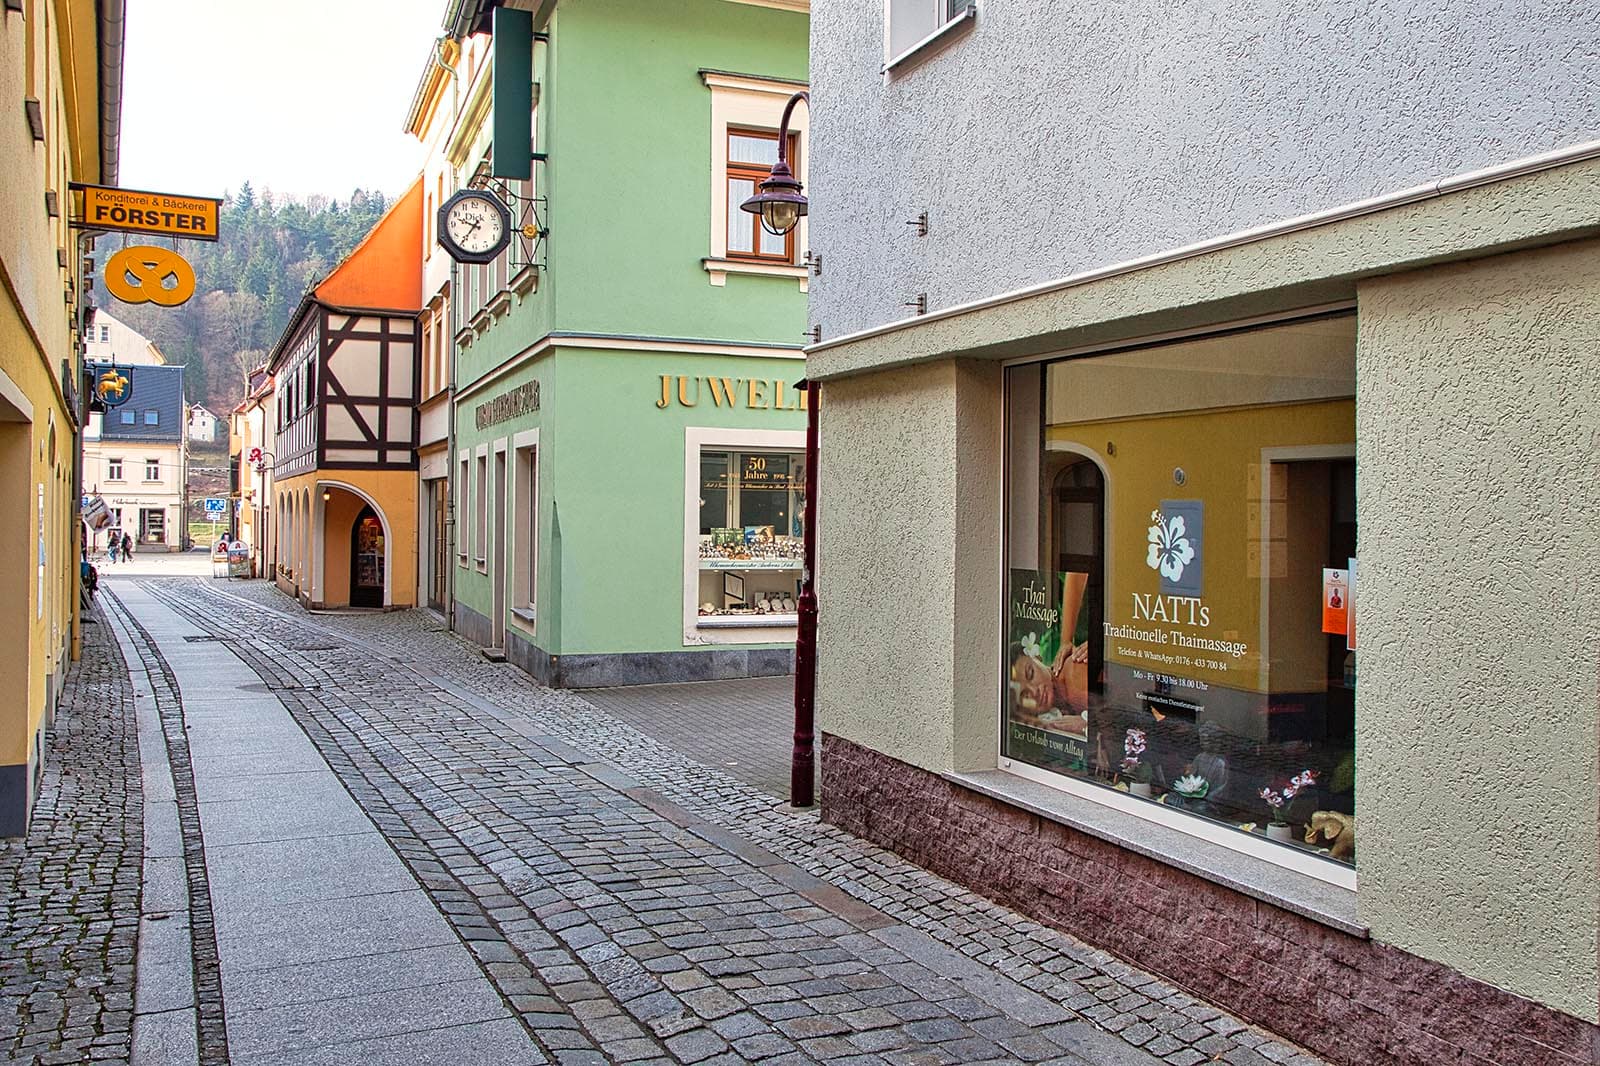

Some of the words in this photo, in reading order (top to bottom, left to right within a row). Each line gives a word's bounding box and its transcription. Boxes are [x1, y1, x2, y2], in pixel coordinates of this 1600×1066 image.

[95, 191, 149, 206] Konditorei
[162, 199, 208, 212] Bäckerei
[95, 203, 207, 231] FÖRSTER
[465, 212, 485, 222] Dick
[744, 470, 768, 480] Jahre
[748, 457, 767, 471] 50
[1022, 581, 1046, 606] Thai
[1016, 602, 1058, 628] Massage
[1132, 592, 1210, 627] NATTs
[1103, 622, 1168, 644] Traditionelle
[1170, 630, 1248, 658] Thaimassage
[1117, 646, 1137, 658] Telefon
[1137, 649, 1143, 658] &
[1144, 650, 1175, 664] WhatsApp:
[1175, 655, 1191, 666] 0176
[1194, 658, 1206, 668] 433
[1207, 660, 1219, 670] 700
[1219, 661, 1227, 672] 84
[1133, 670, 1144, 679] Mo
[1156, 673, 1169, 684] 9.30
[1169, 677, 1178, 685] bis
[1178, 678, 1195, 689] 18.00
[1195, 680, 1209, 691] Uhr
[1013, 728, 1026, 741] Der
[1026, 731, 1049, 747] Urlaub
[1063, 740, 1085, 761] Alltag
